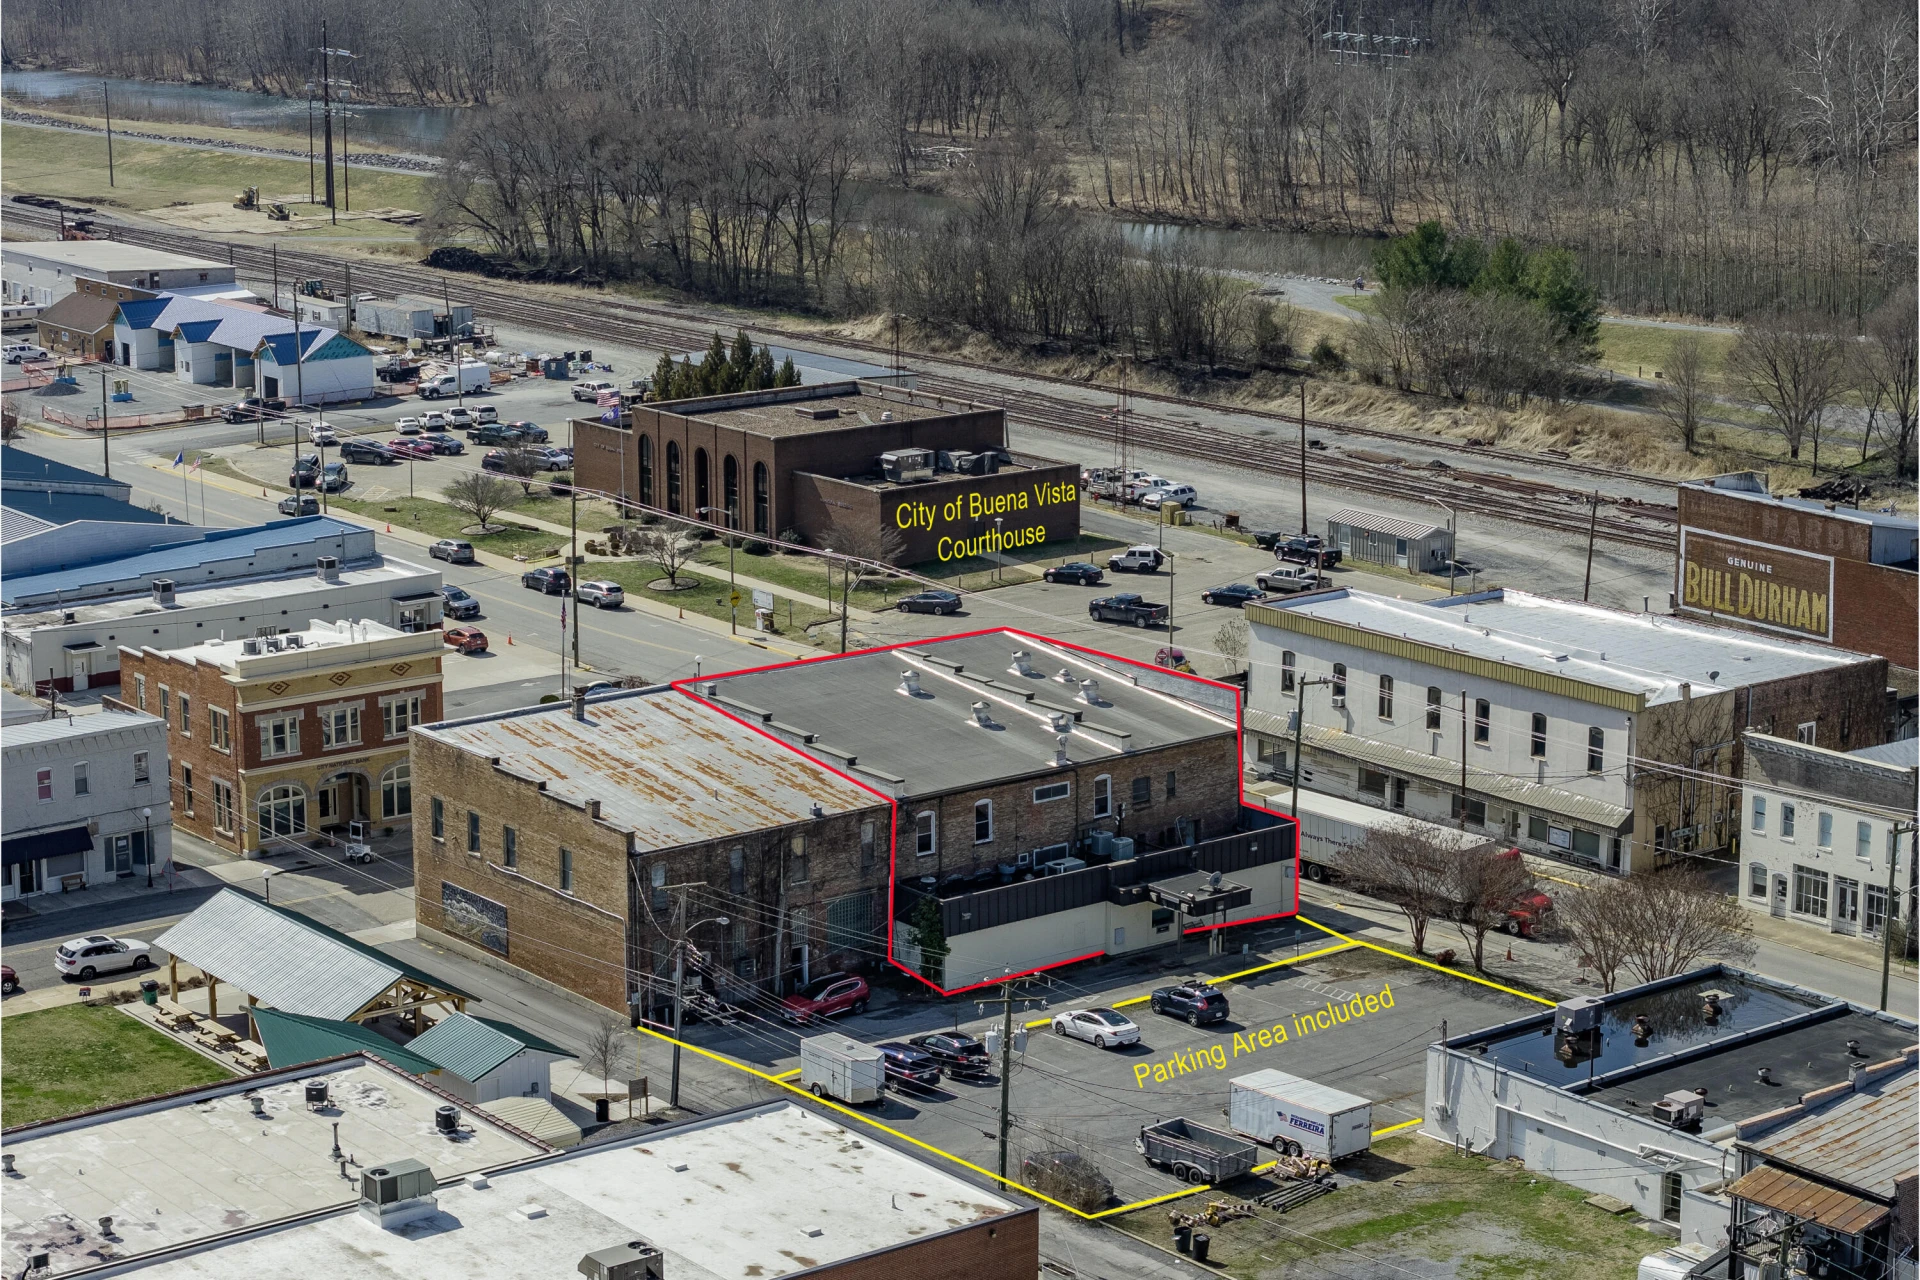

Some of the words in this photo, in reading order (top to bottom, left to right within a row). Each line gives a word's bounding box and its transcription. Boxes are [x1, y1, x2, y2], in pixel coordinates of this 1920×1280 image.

[1727, 556, 1773, 574] GENUINE
[1685, 560, 1735, 612] BULL
[1738, 572, 1827, 633] DURHAM
[1300, 830, 1323, 842] Always
[1324, 837, 1342, 848] There
[1289, 1117, 1325, 1135] FERREIRA
